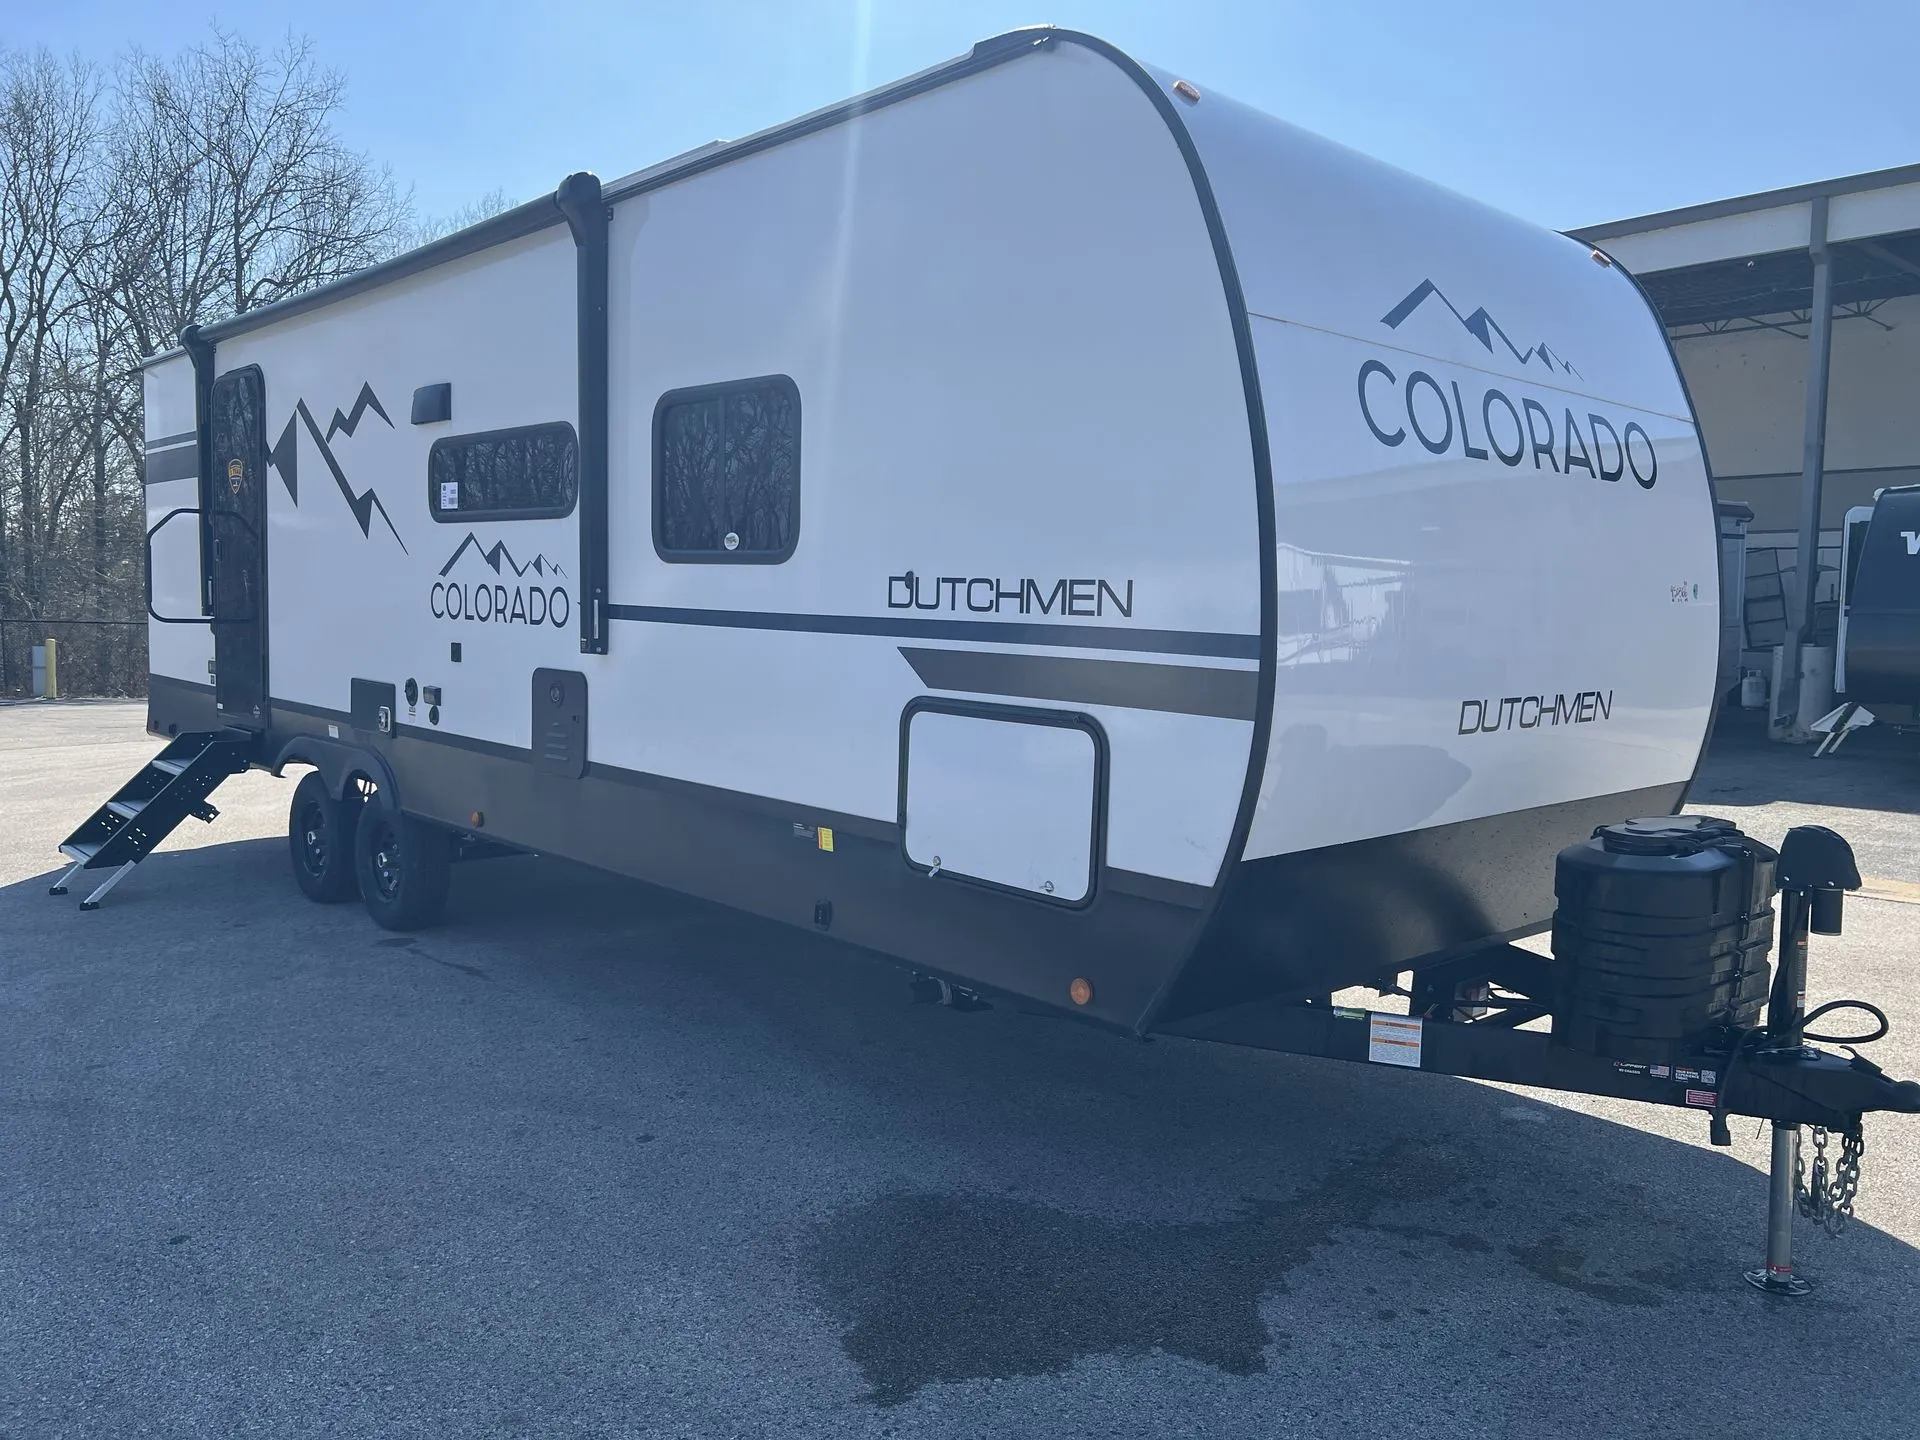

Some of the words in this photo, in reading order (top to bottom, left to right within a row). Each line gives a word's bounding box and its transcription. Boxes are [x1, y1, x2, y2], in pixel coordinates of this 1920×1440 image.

[1358, 359, 1658, 490] COLORADO
[430, 582, 570, 628] COLORADO
[888, 576, 1134, 617] DUTCHMEN
[1458, 690, 1613, 735] DUTCHMEN
